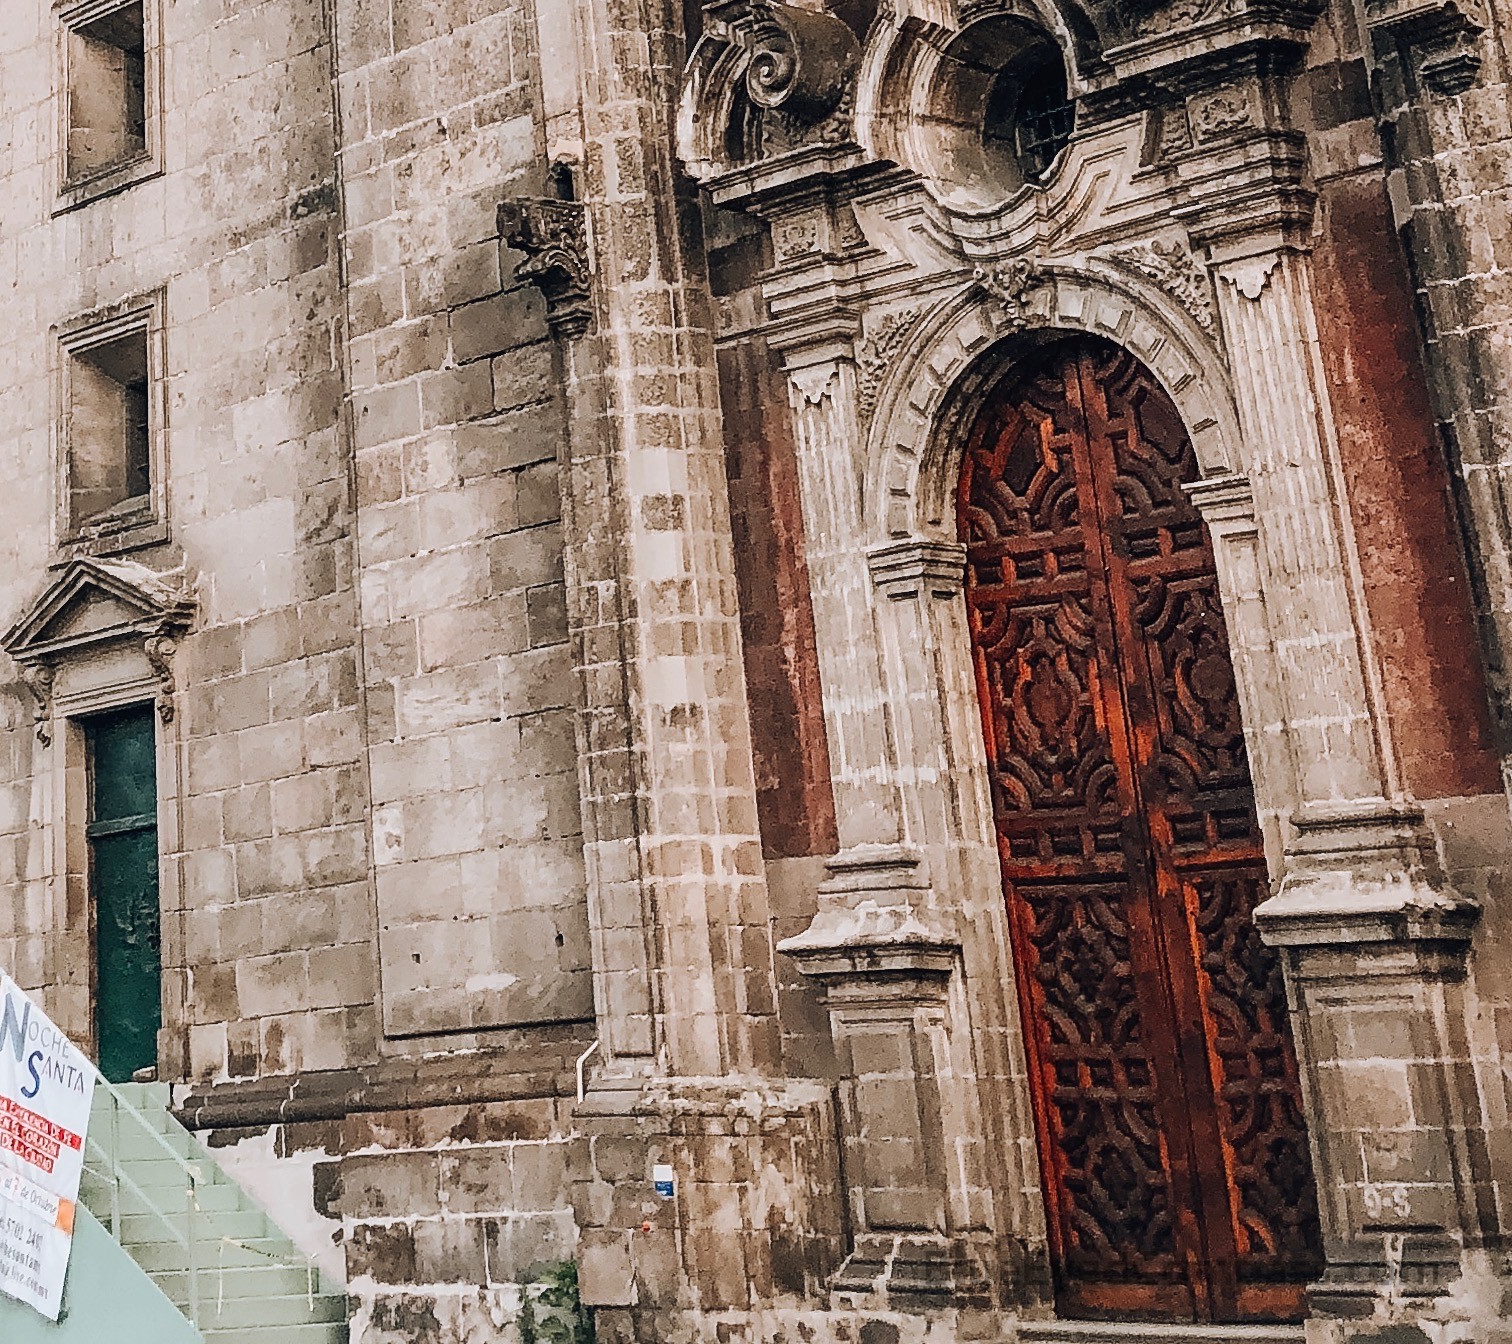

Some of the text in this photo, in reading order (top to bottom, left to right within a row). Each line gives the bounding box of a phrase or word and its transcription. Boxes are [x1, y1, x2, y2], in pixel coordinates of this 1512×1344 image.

[20, 1050, 85, 1099] SANTA
[11, 1118, 20, 1136] EL
[1, 1133, 52, 1171] DE LA CIUDAD
